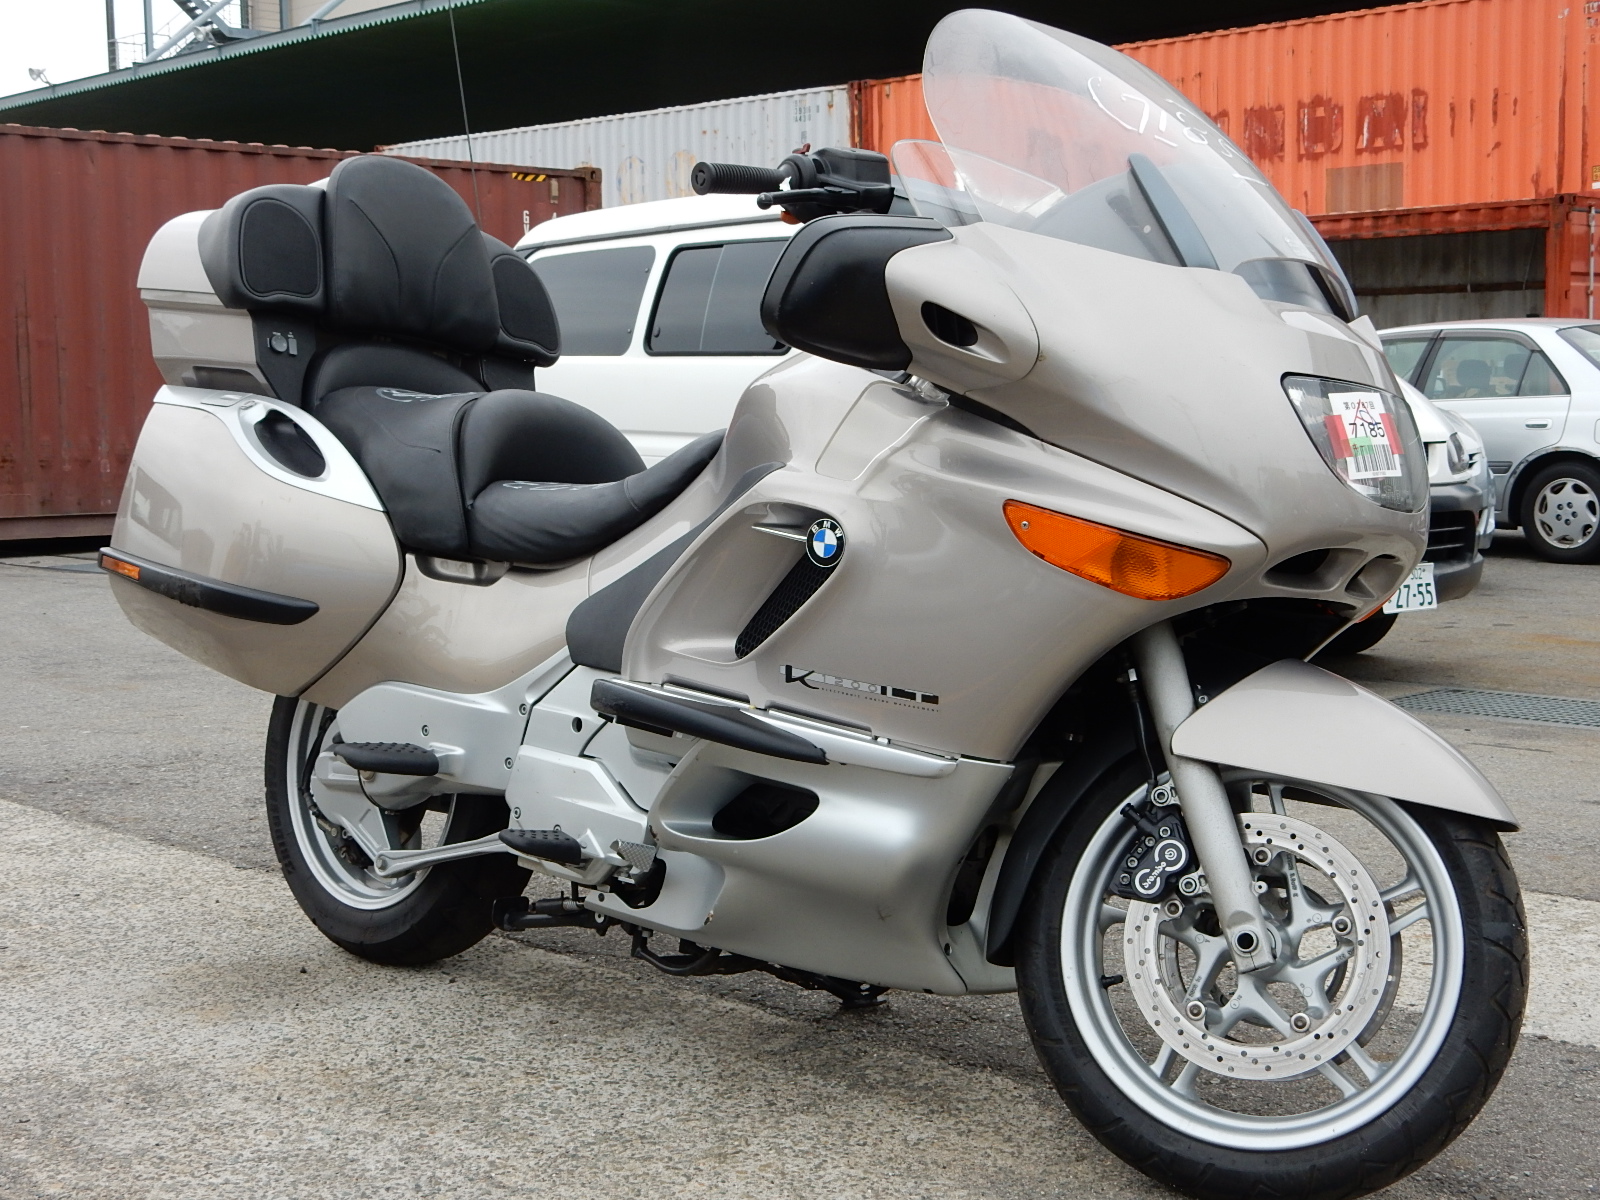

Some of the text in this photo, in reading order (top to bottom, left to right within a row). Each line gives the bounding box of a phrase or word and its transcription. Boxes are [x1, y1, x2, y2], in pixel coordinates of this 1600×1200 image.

[1349, 422, 1386, 438] 7185
[811, 520, 843, 538] BMW
[1142, 861, 1167, 889] brembo
